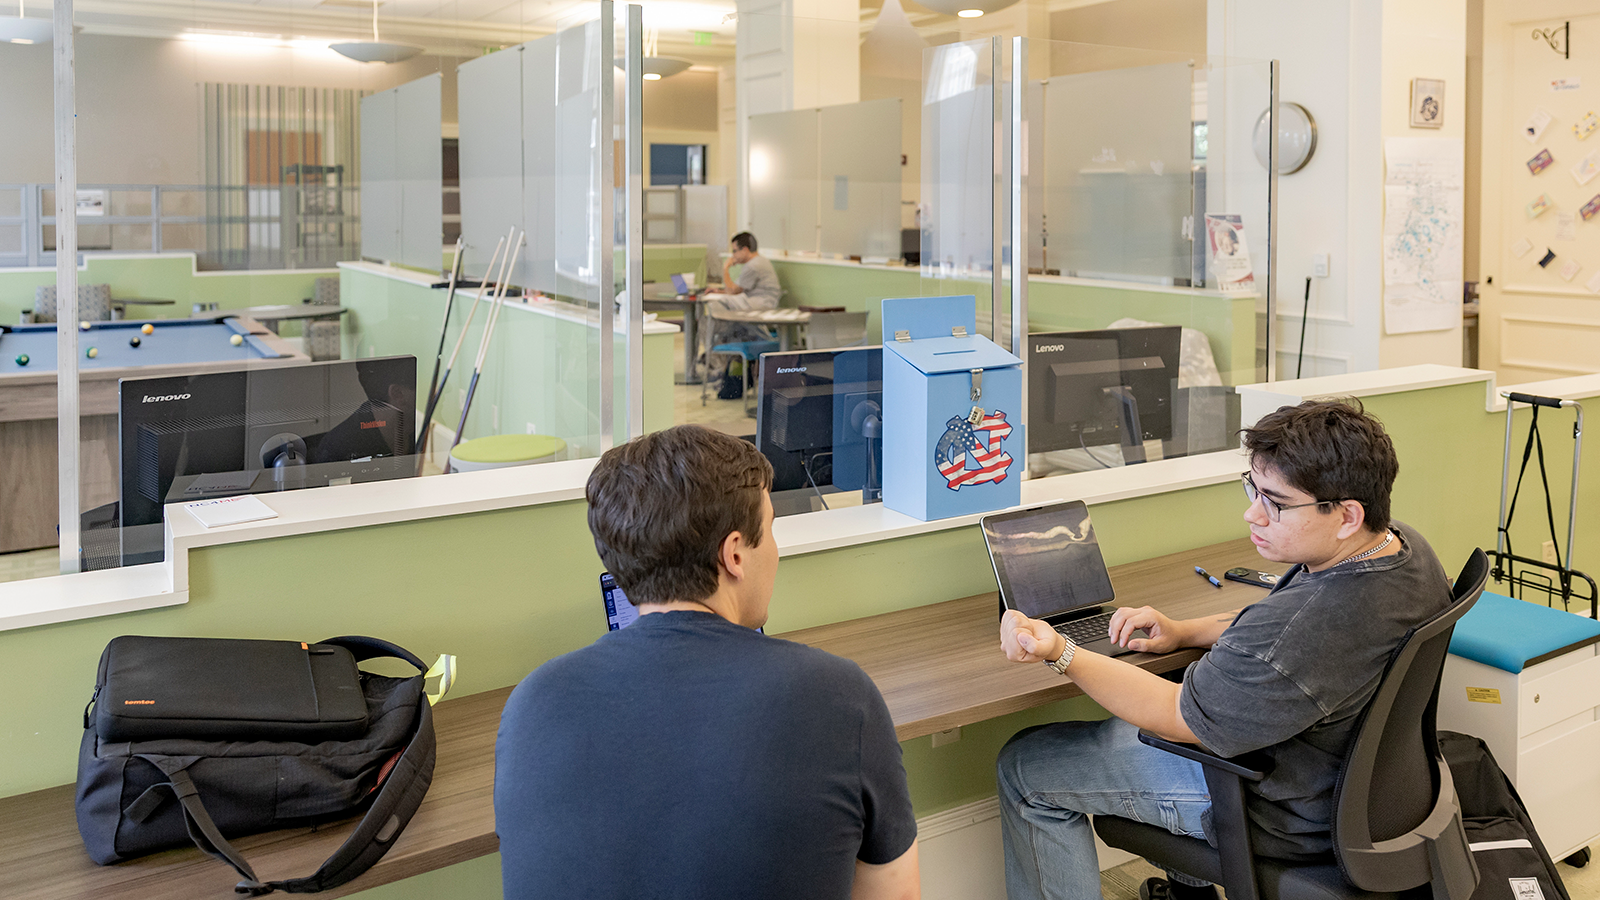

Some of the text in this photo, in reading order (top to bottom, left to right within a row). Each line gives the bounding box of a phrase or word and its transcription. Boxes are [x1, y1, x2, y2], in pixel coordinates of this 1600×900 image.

[1035, 344, 1065, 353] Lenovo
[776, 366, 807, 374] lenovo
[142, 393, 192, 403] lenovo
